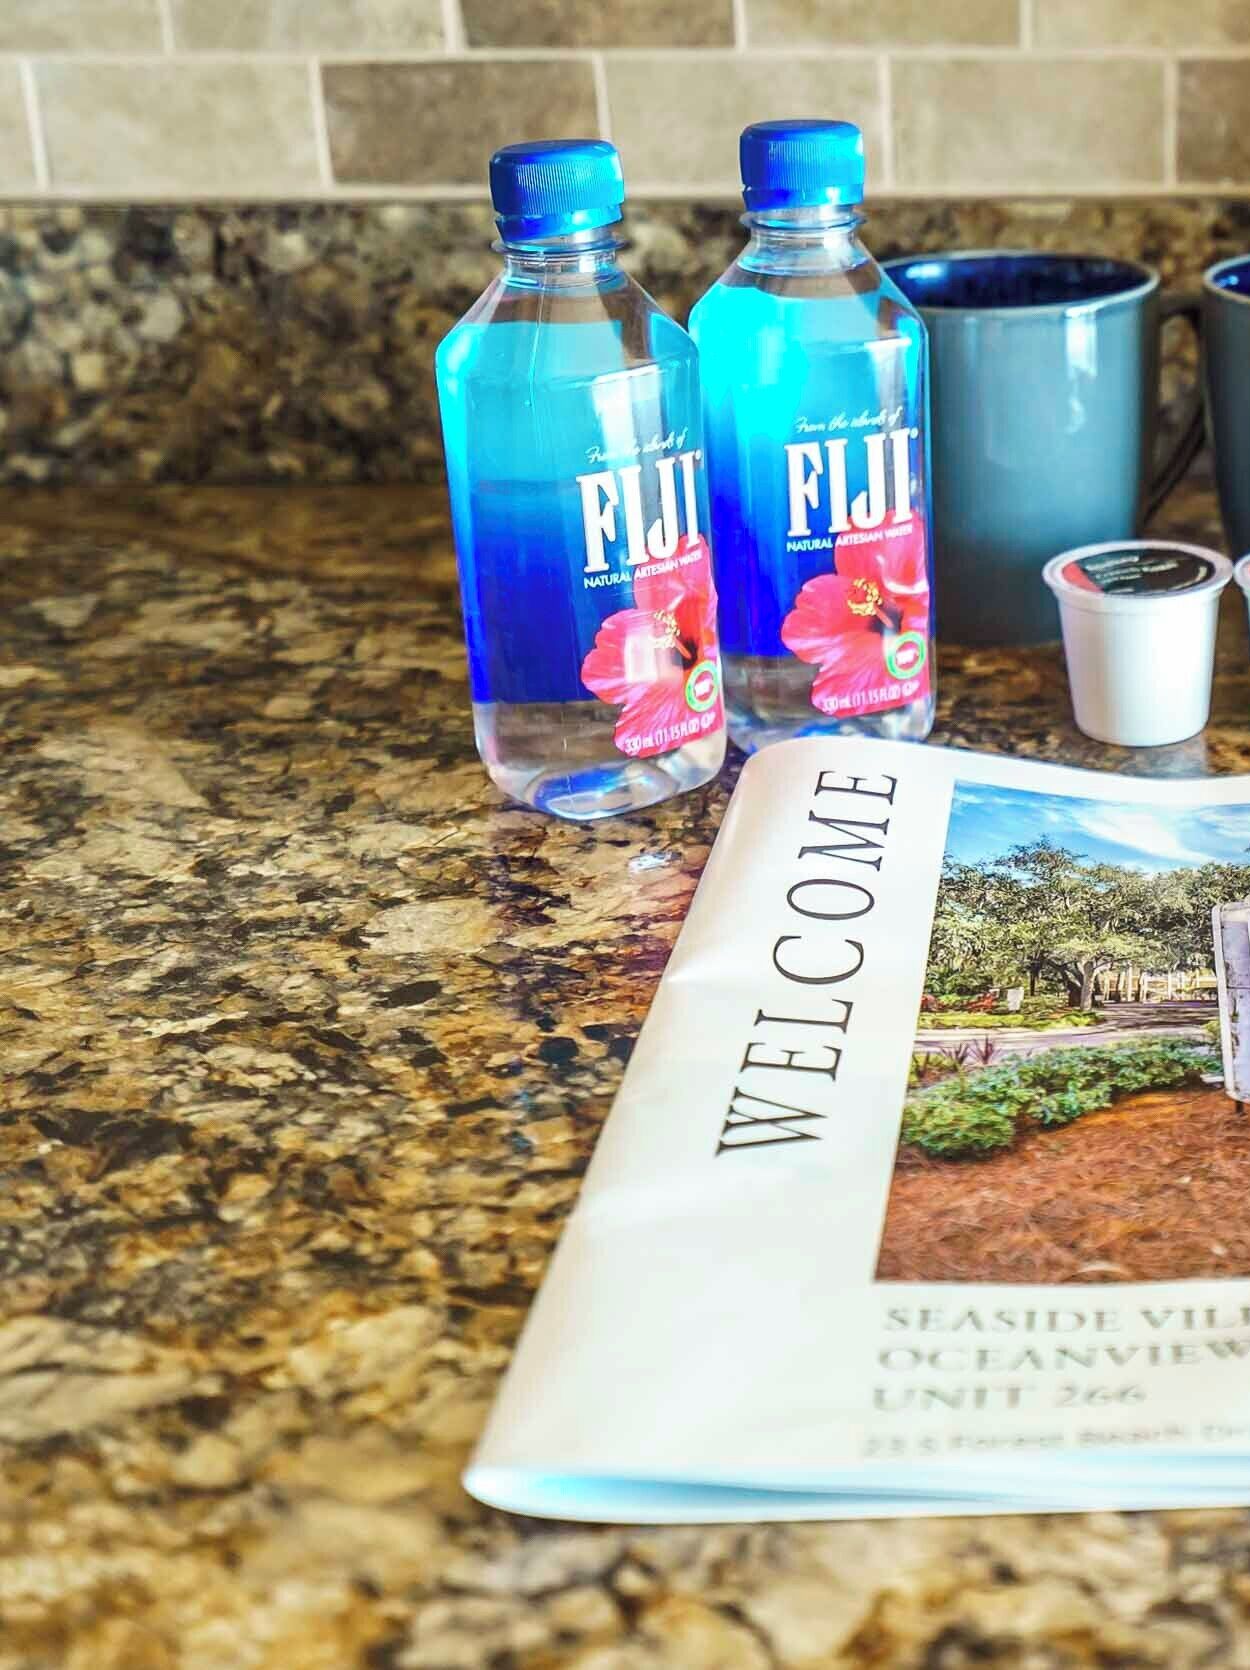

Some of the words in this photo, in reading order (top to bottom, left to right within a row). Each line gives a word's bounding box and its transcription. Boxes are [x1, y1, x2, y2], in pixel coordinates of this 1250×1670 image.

[784, 427, 913, 537] FIJI
[575, 450, 700, 573] FIJI
[786, 538, 833, 552] NATURAL
[835, 530, 883, 546] ARTESIAN
[584, 573, 632, 589] NATURAL
[634, 559, 678, 579] ARTESIAN
[714, 770, 898, 1158] WELCOME
[884, 1307, 1122, 1333] SEASIDE
[872, 1383, 1036, 1412] UNIT
[1055, 1382, 1148, 1409] 266
